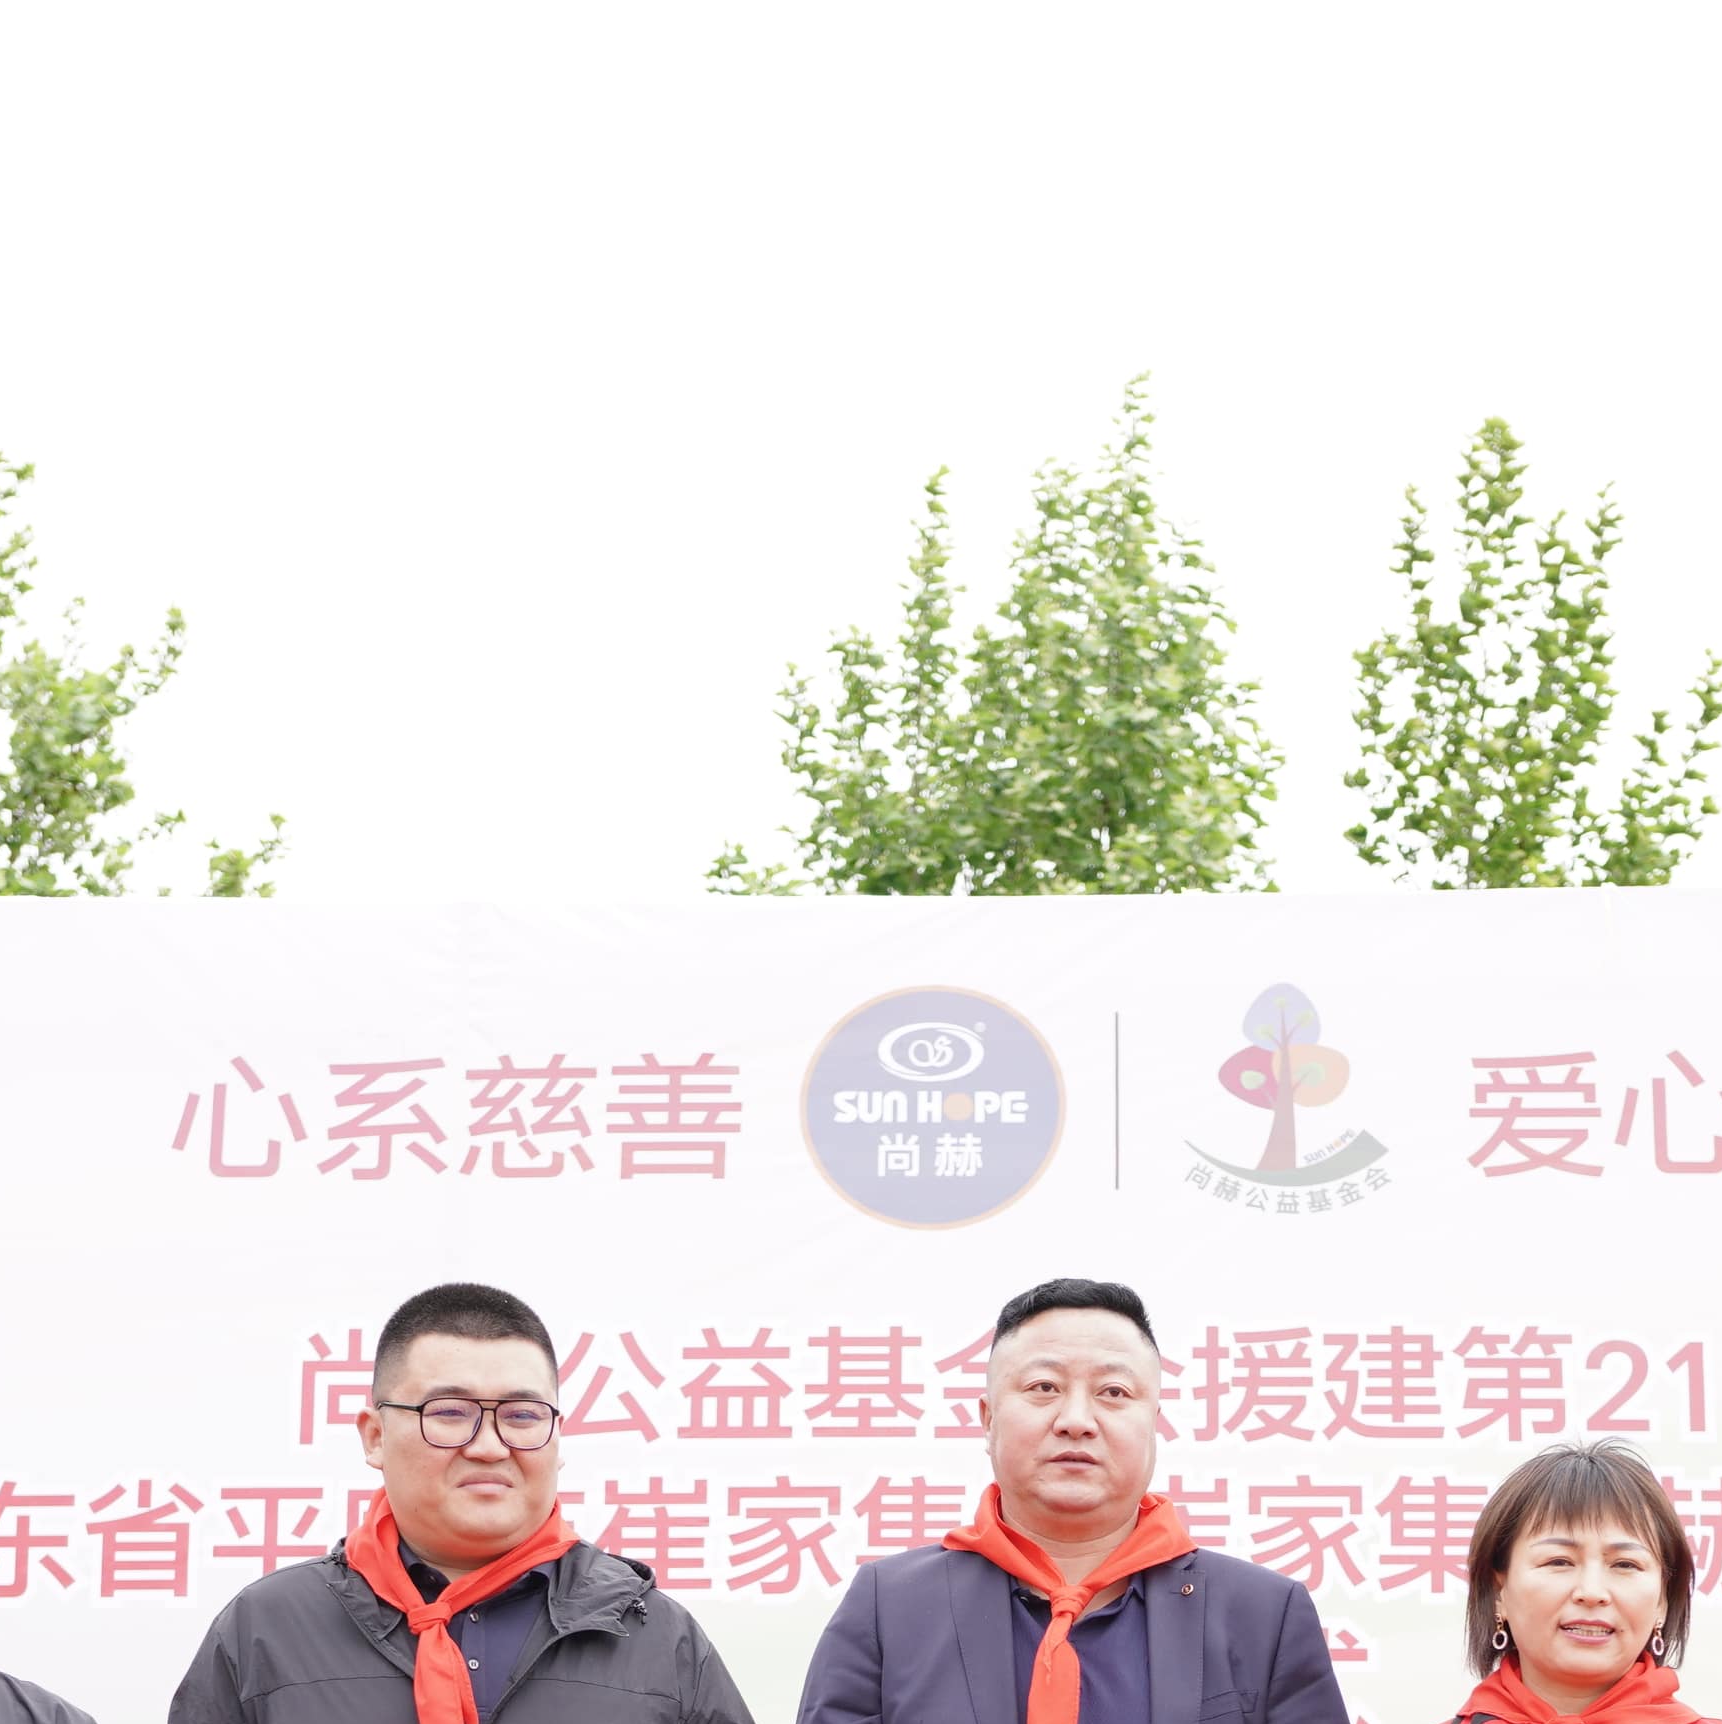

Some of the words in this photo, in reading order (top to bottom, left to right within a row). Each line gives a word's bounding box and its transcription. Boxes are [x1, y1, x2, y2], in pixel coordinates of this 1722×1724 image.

[173, 1053, 743, 1180] 心系慈善
[833, 1090, 908, 1123] SUN
[917, 1090, 1030, 1123] HOPE
[877, 1133, 983, 1177] 尚赫
[1185, 1163, 1392, 1214] 尚赫公益基金会
